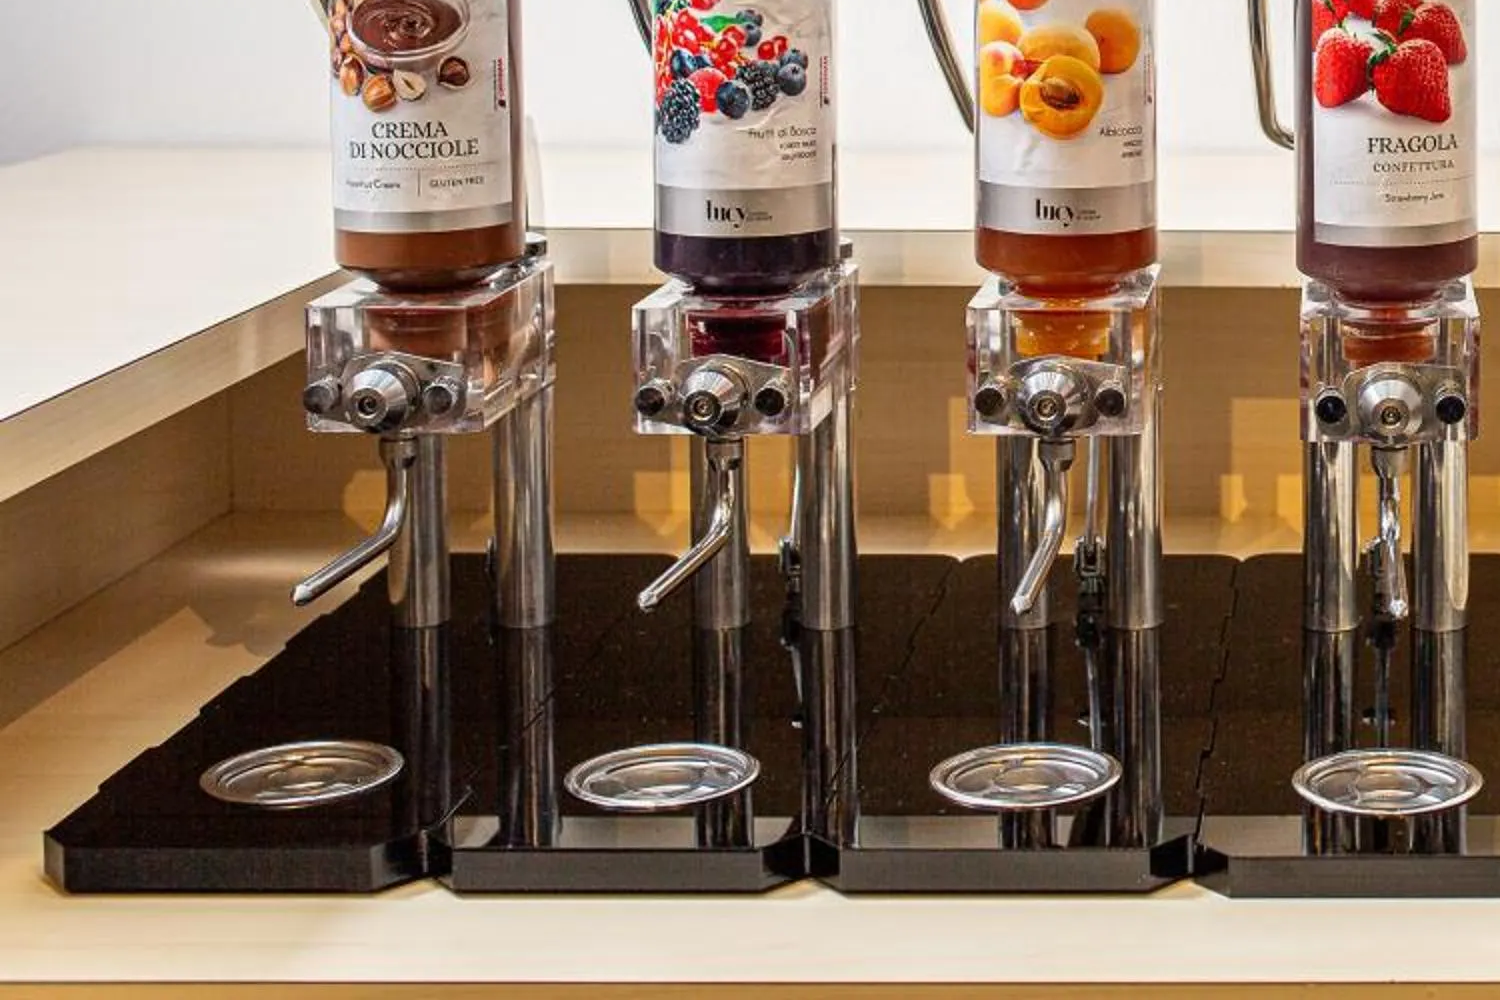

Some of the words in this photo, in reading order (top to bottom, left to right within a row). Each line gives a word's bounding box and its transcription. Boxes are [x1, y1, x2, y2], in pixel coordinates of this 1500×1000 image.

[371, 121, 448, 139] CREMA
[350, 141, 366, 159] DI
[371, 139, 479, 159] NOCCIOLE
[1367, 133, 1458, 153] FRAGOLA
[1373, 160, 1454, 173] CONFETTURA
